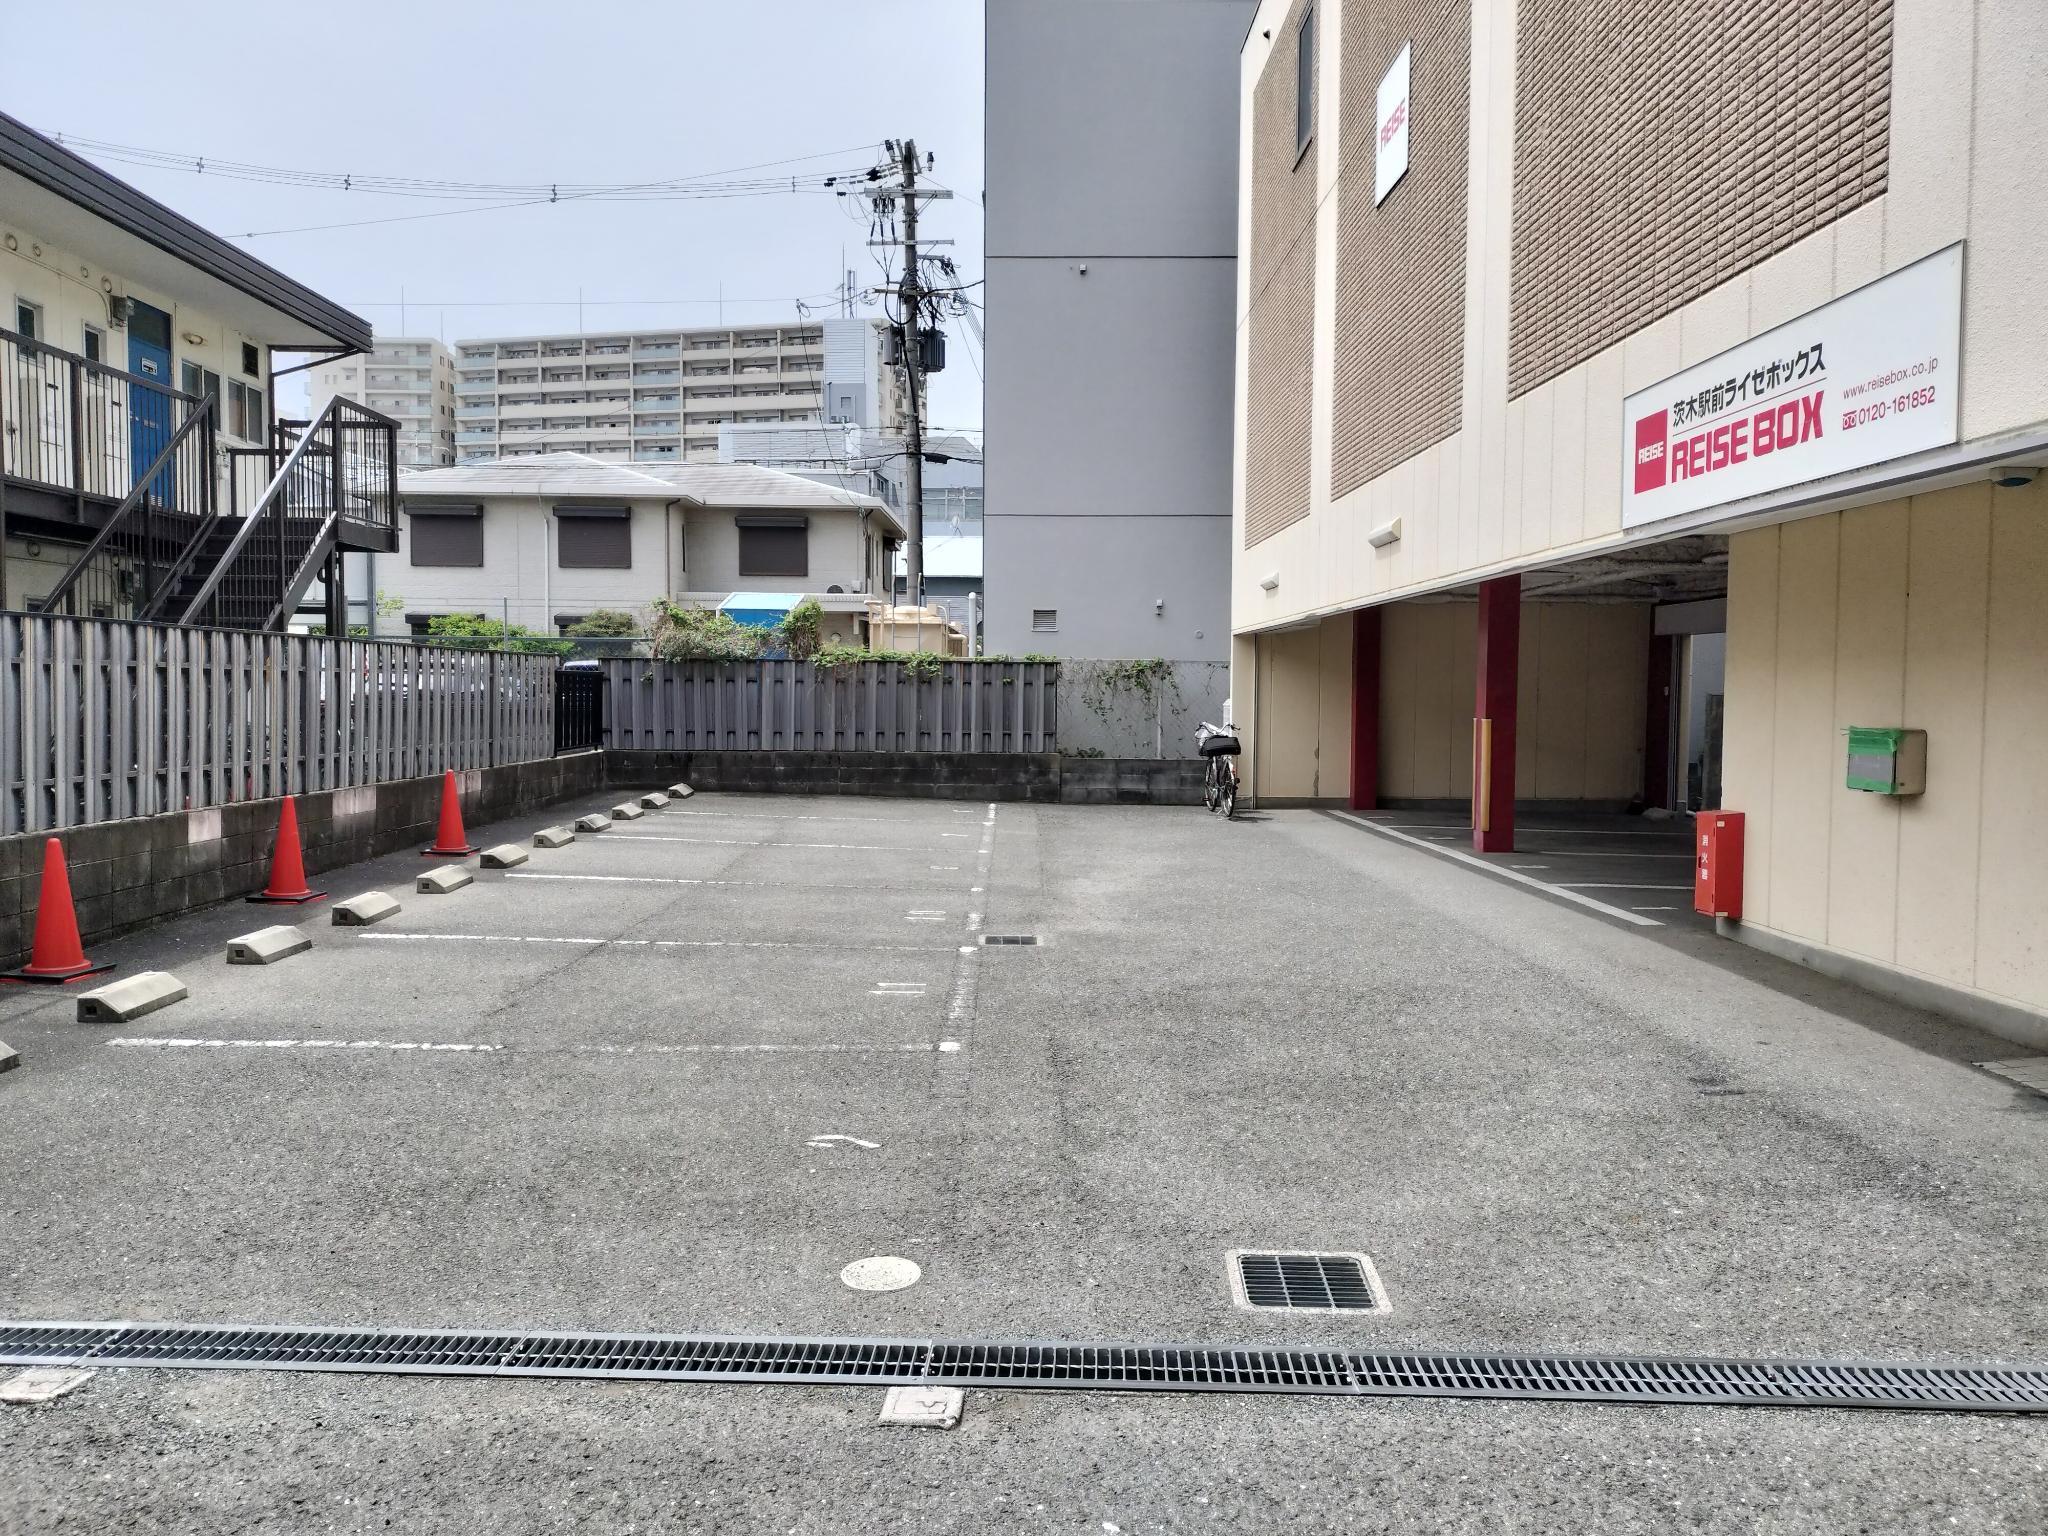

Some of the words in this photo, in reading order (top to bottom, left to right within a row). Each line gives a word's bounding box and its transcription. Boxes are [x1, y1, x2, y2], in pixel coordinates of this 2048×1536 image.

[1380, 96, 1406, 153] REISE
[1672, 343, 1826, 428] 茨木駅前ライゼボックス
[1842, 356, 1939, 400] www.reisebox.co.jp
[1858, 385, 1936, 426] 0120-161852
[1637, 442, 1664, 465] REISE
[1671, 416, 1749, 484] REISE
[1752, 390, 1826, 459] BOX
